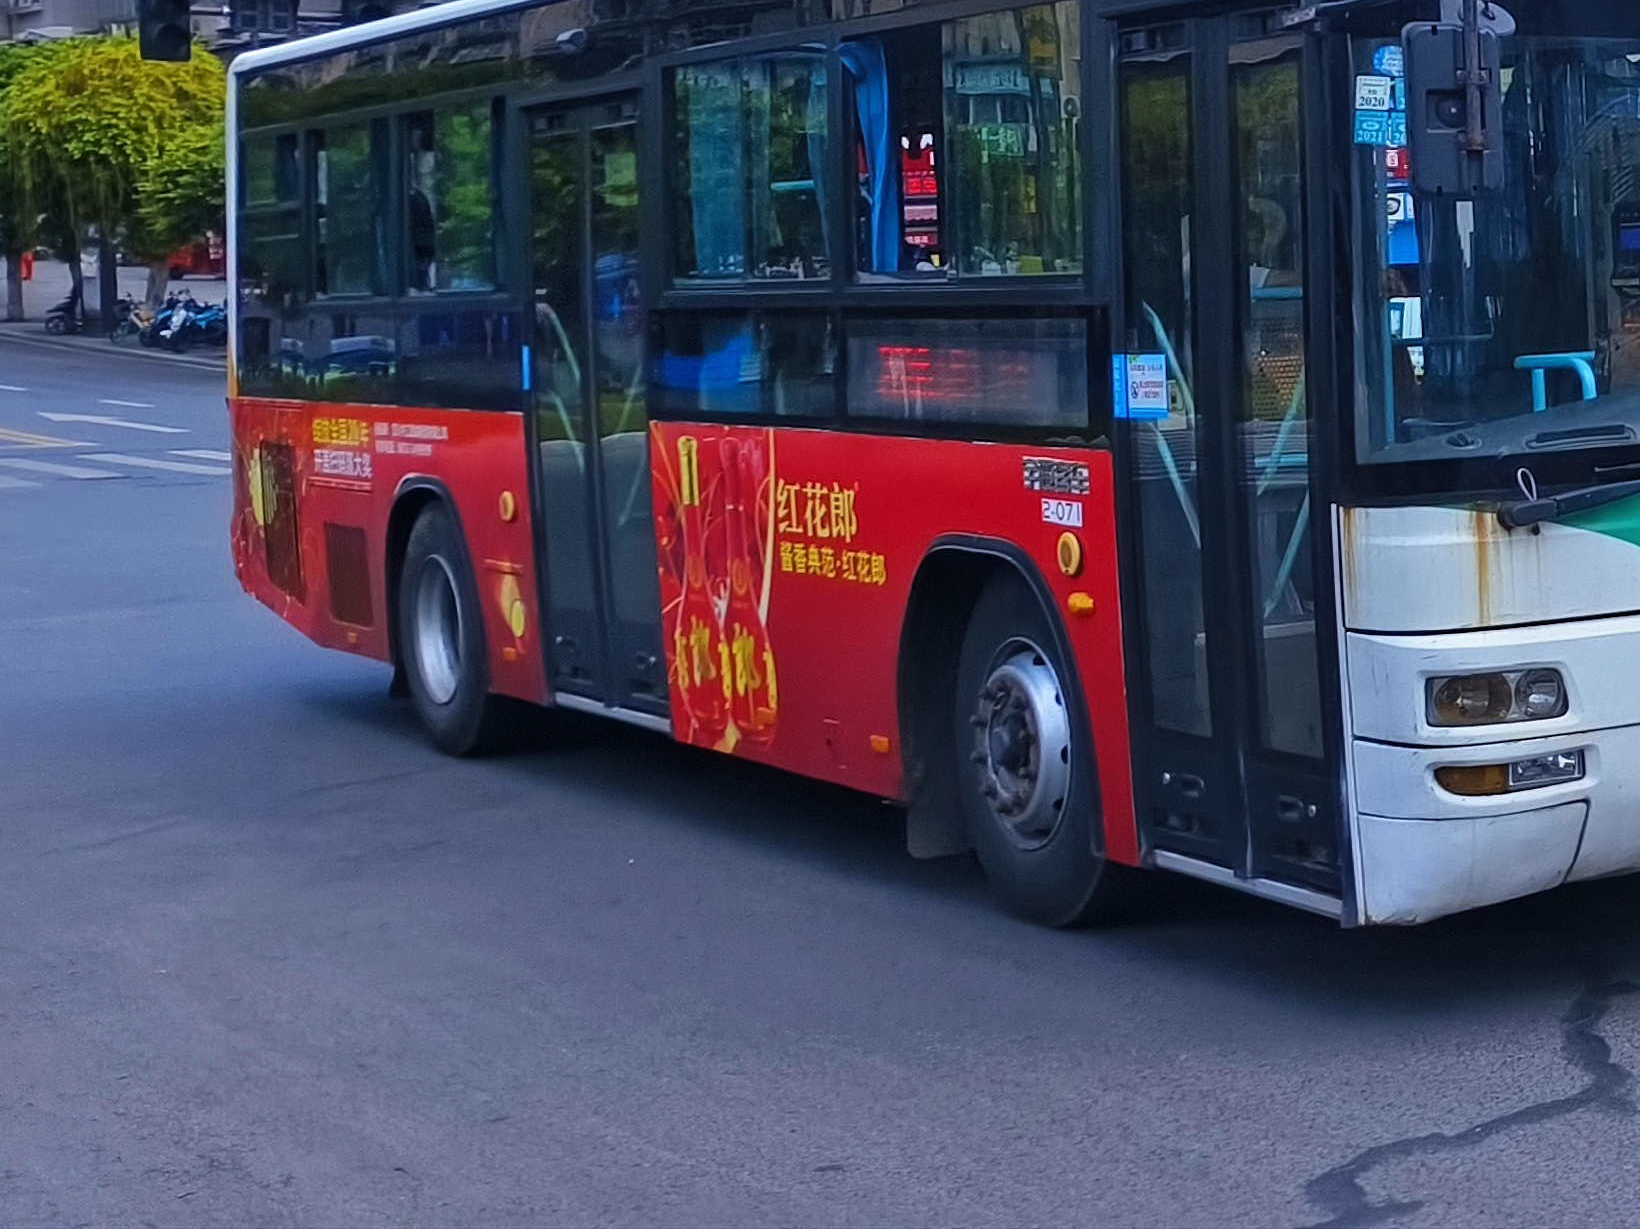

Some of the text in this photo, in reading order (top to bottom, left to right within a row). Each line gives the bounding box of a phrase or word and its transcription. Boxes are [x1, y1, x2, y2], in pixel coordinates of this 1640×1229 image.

[1358, 96, 1385, 107] 2020
[1357, 130, 1383, 142] 2021
[776, 478, 858, 543] 红花郎
[1043, 500, 1081, 523] 2-071
